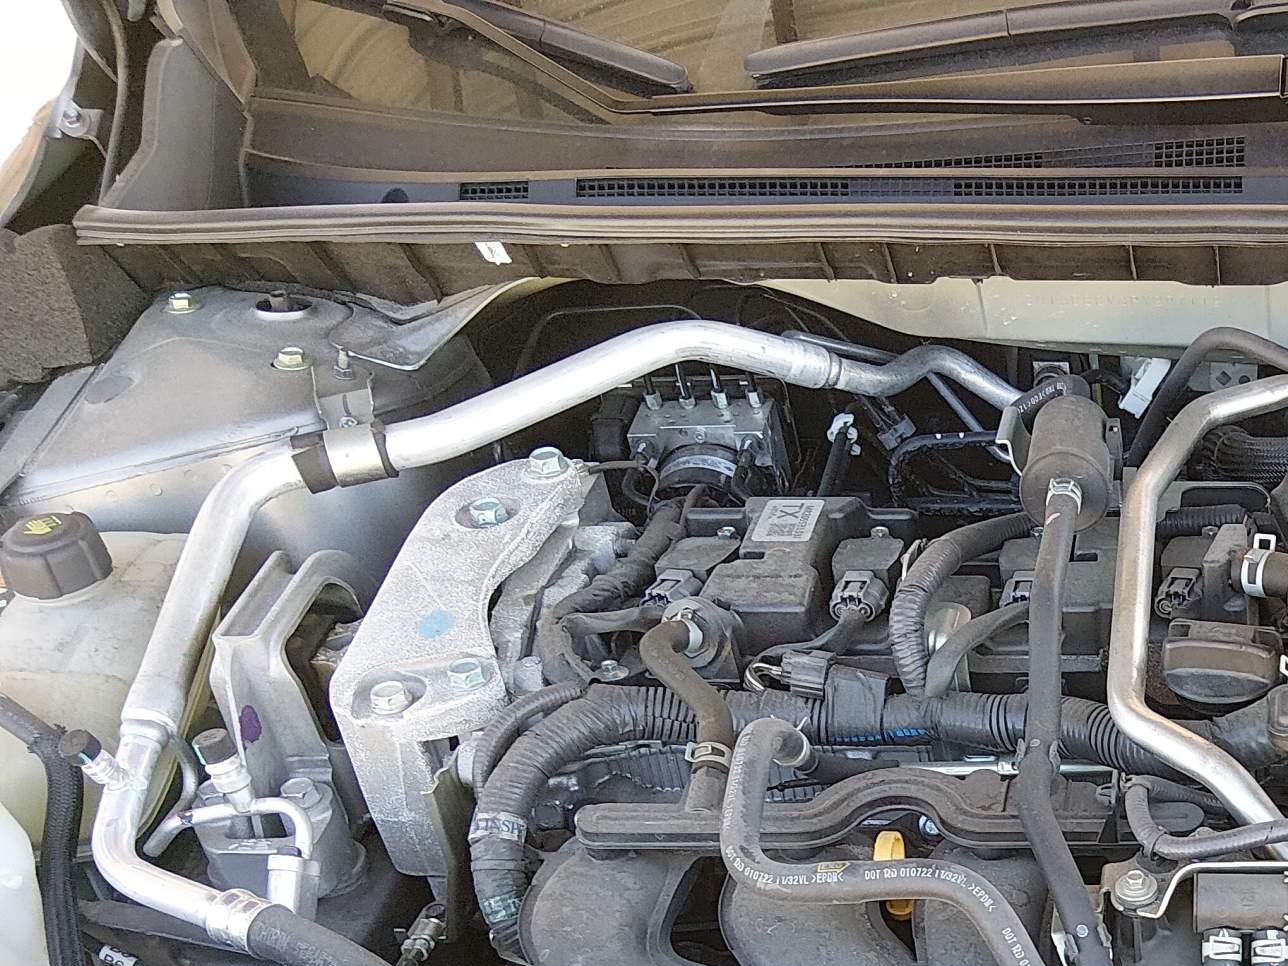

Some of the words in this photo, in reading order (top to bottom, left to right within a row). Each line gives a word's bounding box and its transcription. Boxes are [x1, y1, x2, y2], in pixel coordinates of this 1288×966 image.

[777, 503, 804, 519] TX
[744, 867, 774, 884] 010722
[864, 868, 881, 880] DOT
[899, 866, 934, 878] 010722
[1001, 927, 1018, 948] DOT
